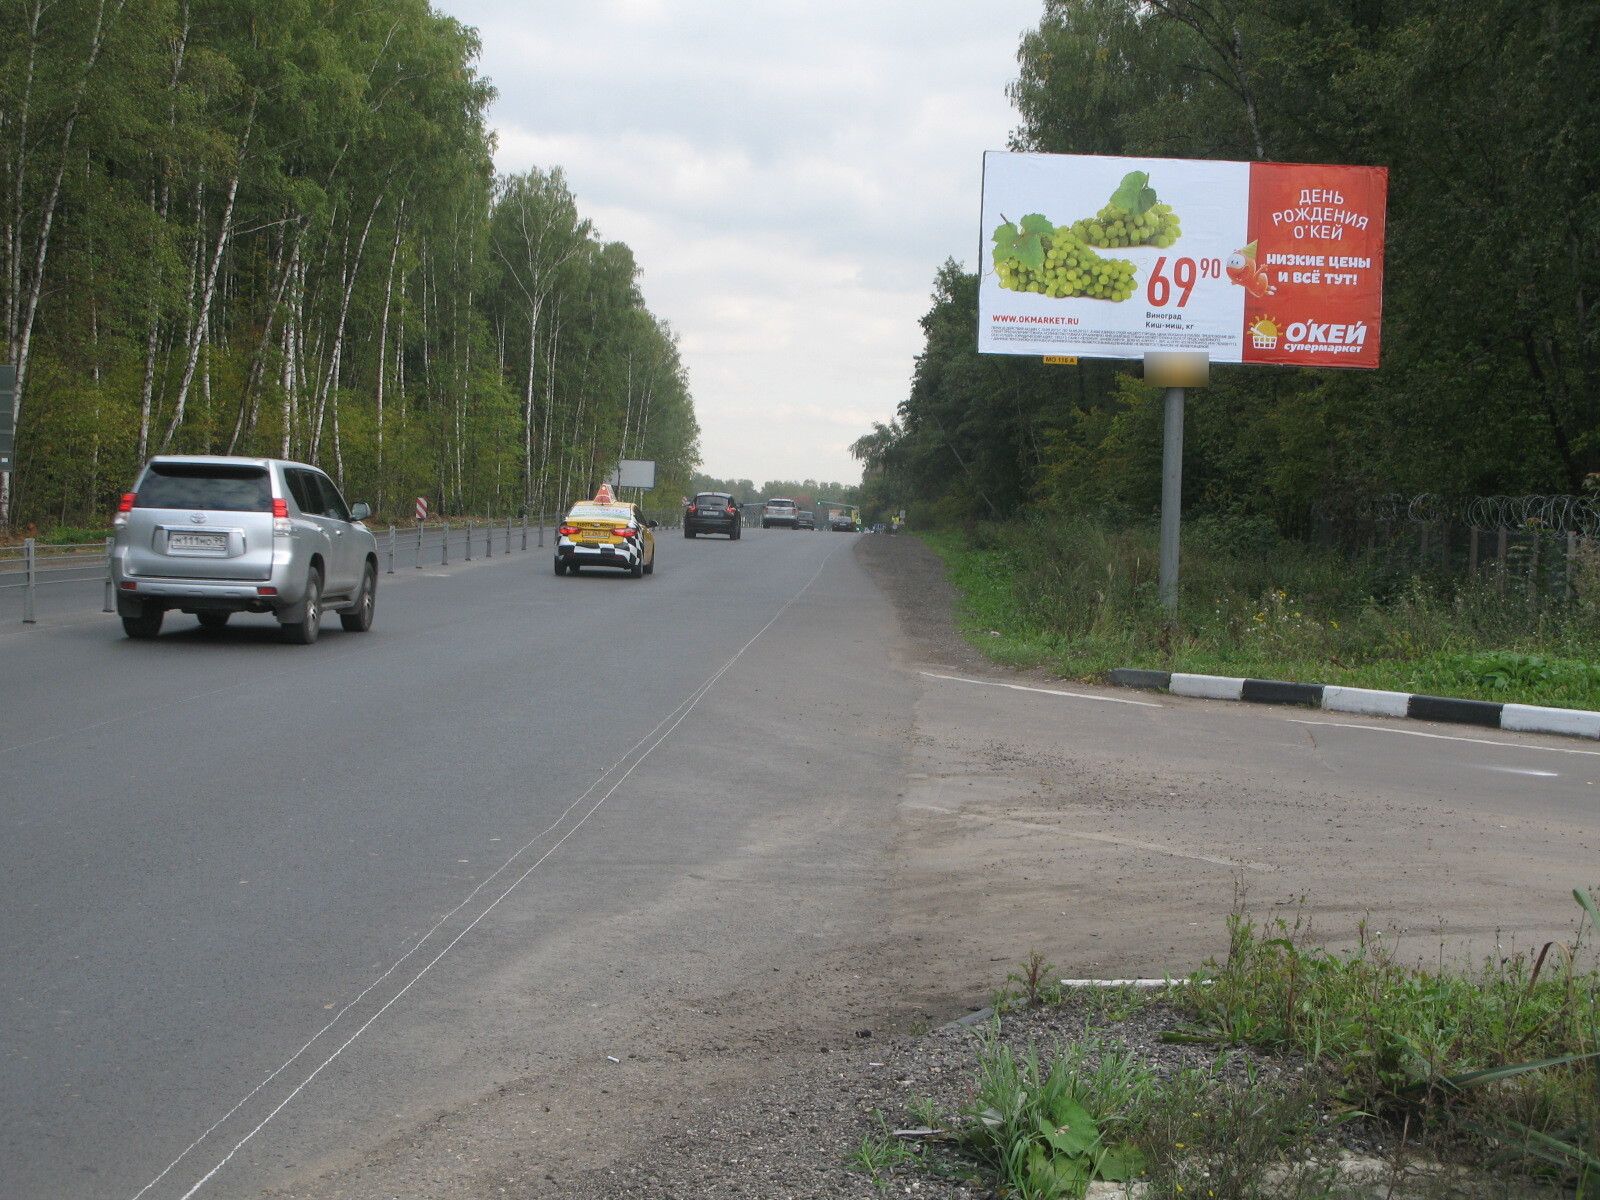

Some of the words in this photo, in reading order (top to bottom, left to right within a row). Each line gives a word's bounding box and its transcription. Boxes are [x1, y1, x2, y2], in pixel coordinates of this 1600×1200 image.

[1299, 189, 1344, 205] ДЕНЬ
[1272, 207, 1369, 231] РОЖДЕНИЯ
[1294, 224, 1343, 240] О'КЕЙ
[1266, 254, 1325, 267] НИЗКИЕ
[1328, 256, 1371, 269] ЦЕНЫ
[1147, 257, 1197, 308] 69
[1200, 258, 1221, 279] 90
[1278, 271, 1288, 283] И
[1292, 269, 1321, 284] ВСЁ
[1324, 273, 1358, 285] ТУТ!
[992, 314, 1080, 326] WWW.OKMARKET.RU
[1146, 311, 1182, 321] Виноград
[1145, 321, 1185, 331] Киш-миш,
[1186, 323, 1195, 331] кг
[1284, 342, 1363, 355] супермаркет
